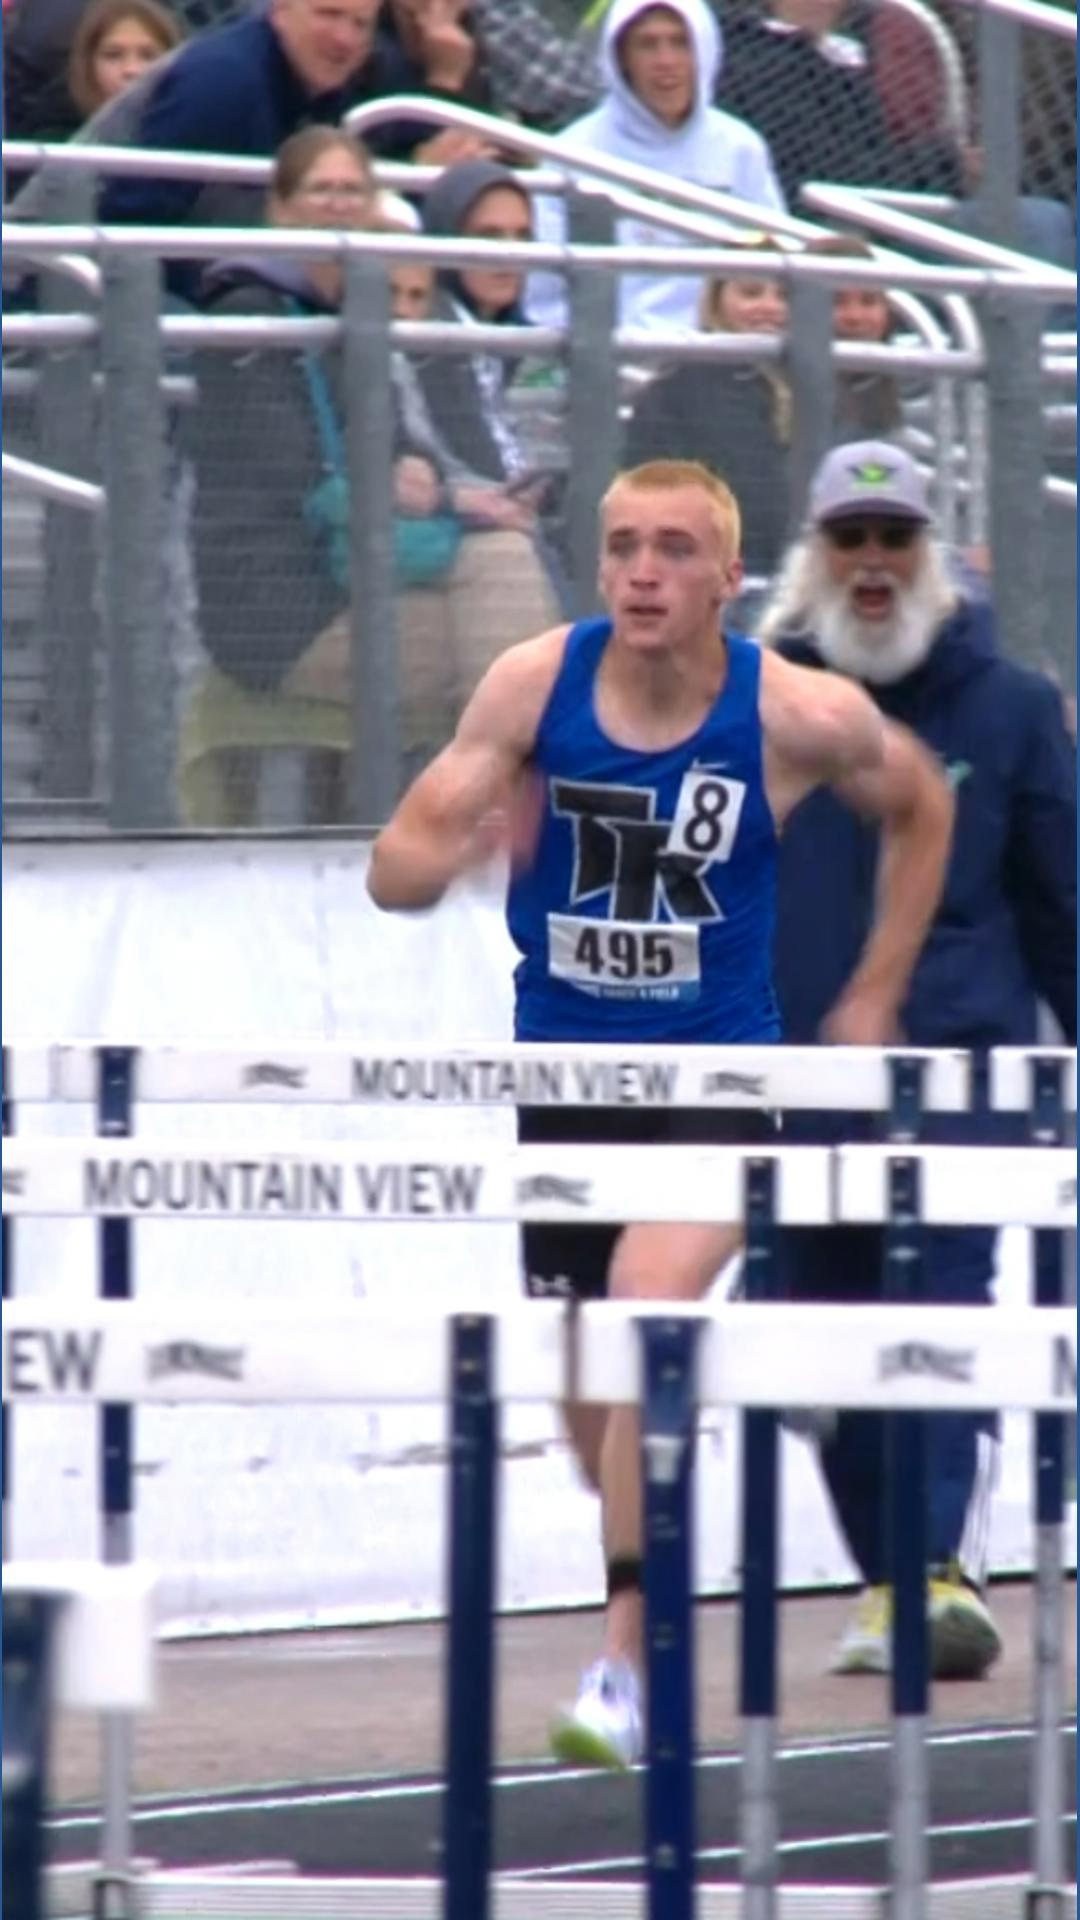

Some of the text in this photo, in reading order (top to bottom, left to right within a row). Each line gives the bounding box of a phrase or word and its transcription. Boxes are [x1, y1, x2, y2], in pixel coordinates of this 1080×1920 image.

[683, 780, 729, 852] 8
[573, 926, 674, 980] 495
[350, 1057, 564, 1101] MOUNTAIN
[572, 1060, 680, 1103] VIEW
[84, 1158, 343, 1211] MOUNTAIN
[357, 1164, 484, 1215] VIEW
